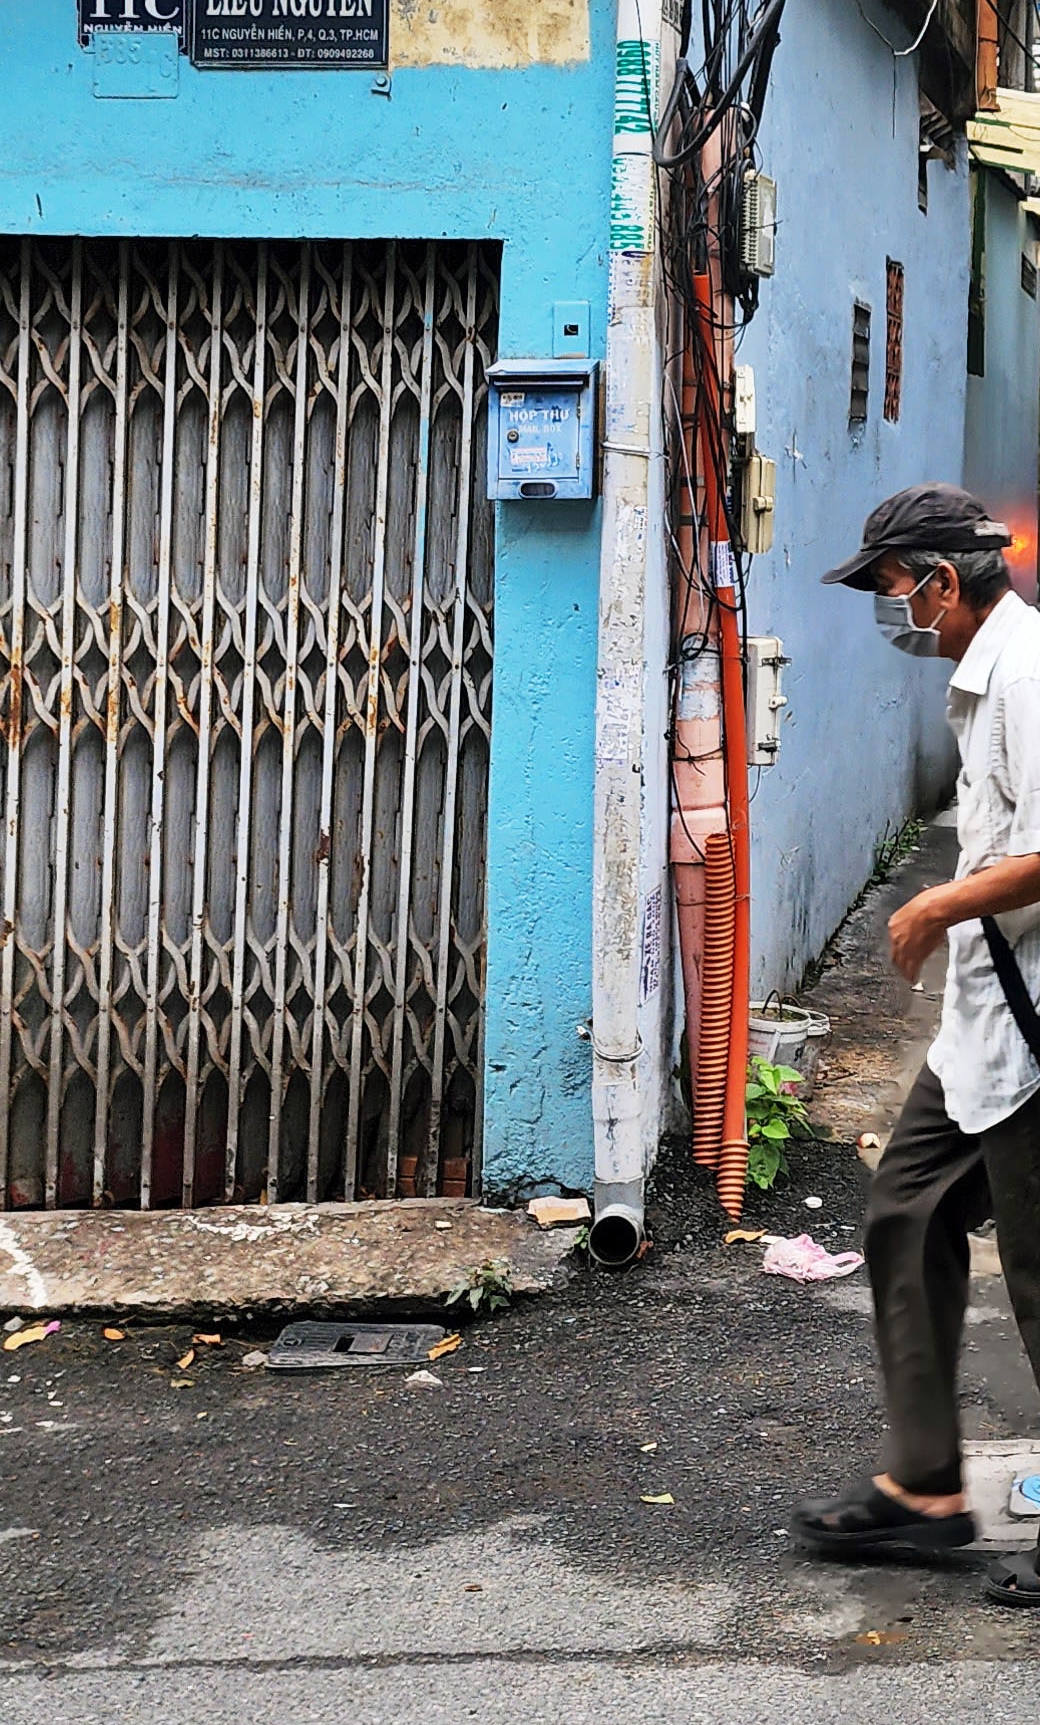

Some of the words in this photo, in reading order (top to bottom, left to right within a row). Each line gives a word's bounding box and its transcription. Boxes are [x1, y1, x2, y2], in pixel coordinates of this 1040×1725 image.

[200, 28, 221, 40] 11C
[339, 29, 379, 41] TP.HCM
[204, 47, 230, 58] MST:
